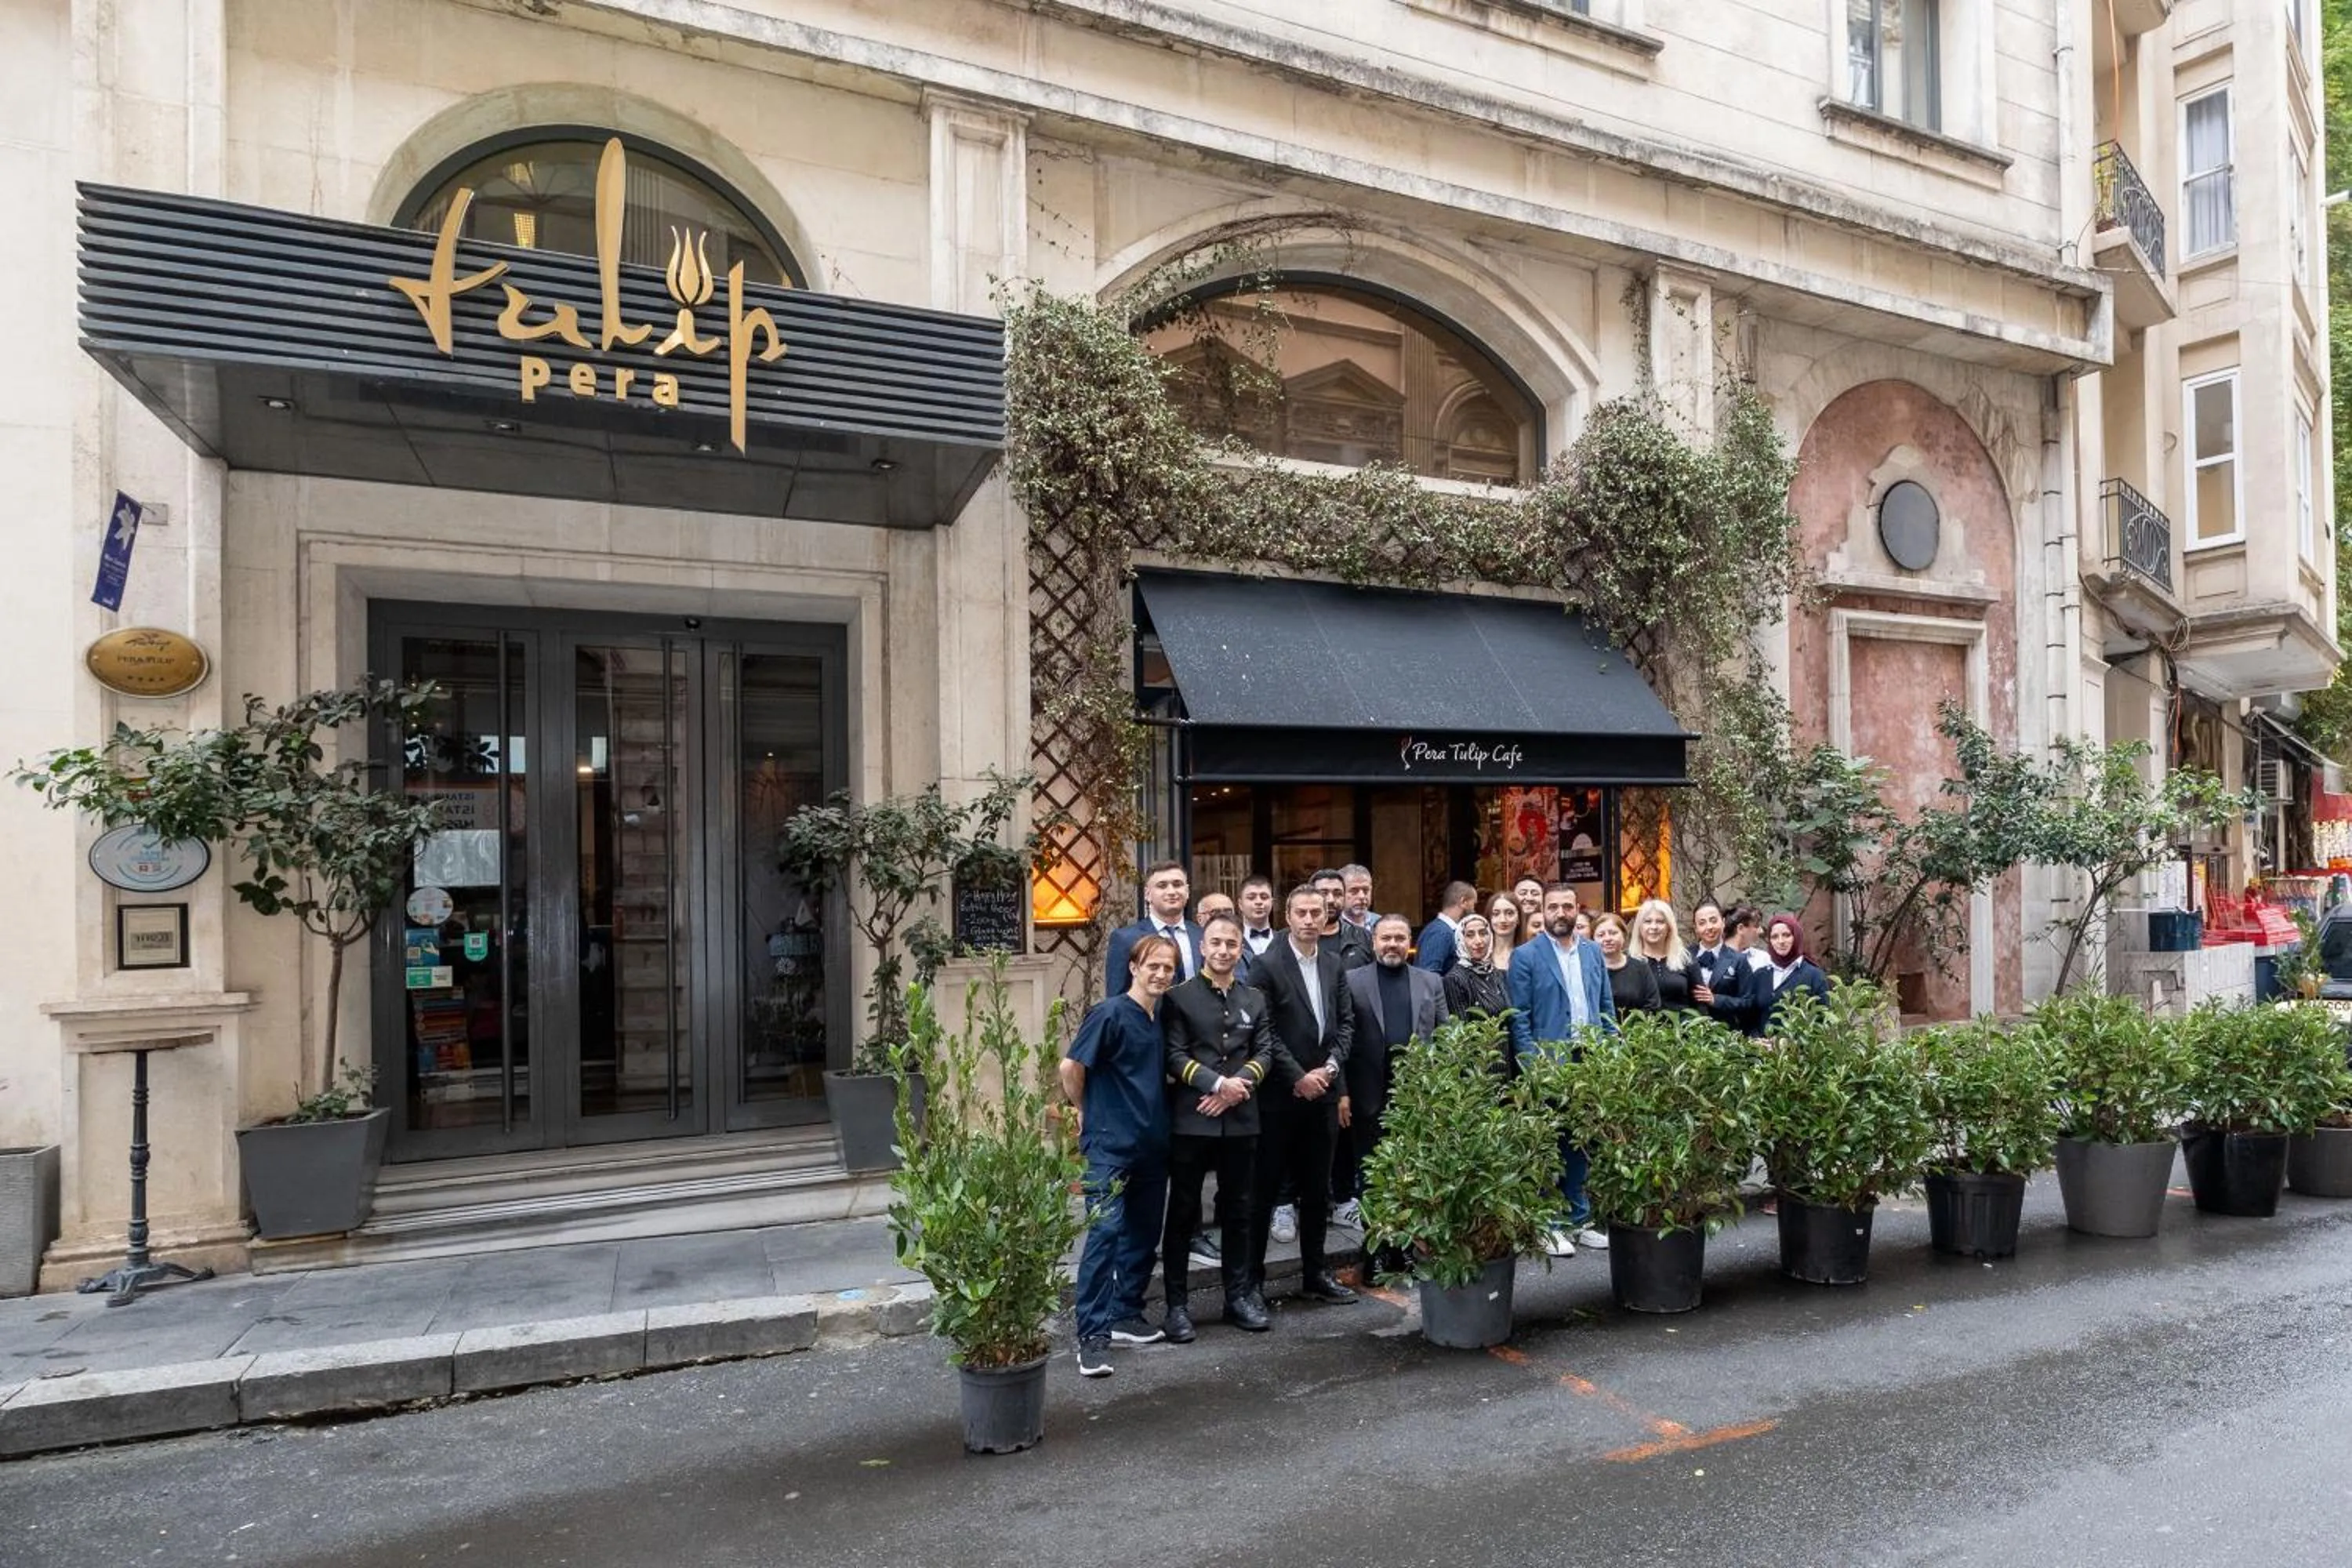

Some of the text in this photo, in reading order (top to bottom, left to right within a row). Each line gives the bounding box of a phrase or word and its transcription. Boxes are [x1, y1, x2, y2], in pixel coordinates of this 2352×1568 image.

[1412, 742, 1523, 770] Pera Tulip Cafe
